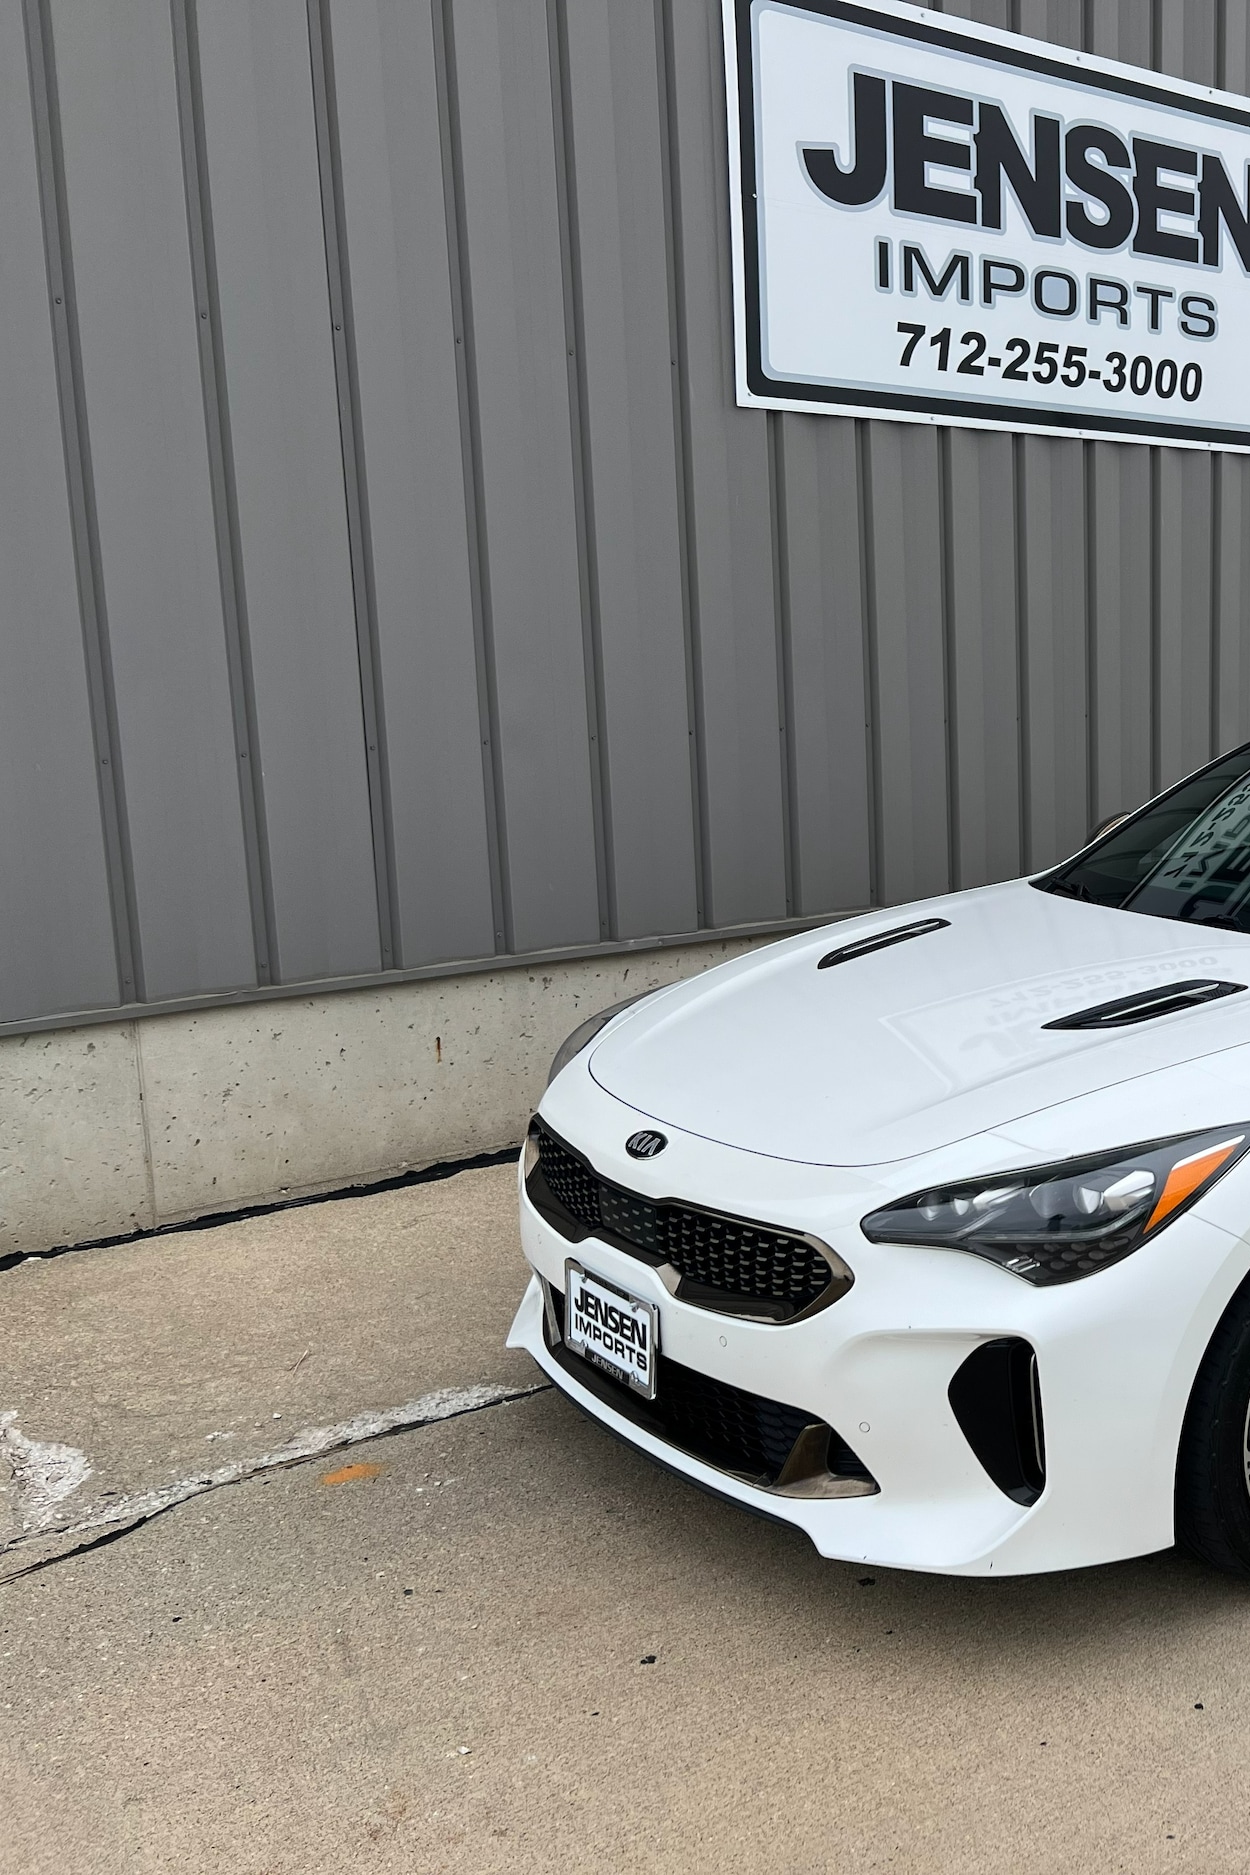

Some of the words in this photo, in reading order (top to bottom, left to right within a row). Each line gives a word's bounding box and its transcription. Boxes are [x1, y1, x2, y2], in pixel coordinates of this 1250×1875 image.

[877, 240, 1217, 339] IMPORTS
[896, 321, 1203, 402] 712-255-3000
[627, 1131, 662, 1156] KIA
[574, 1286, 647, 1351] JENSEN
[574, 1313, 648, 1372] IMPORTS
[590, 1354, 624, 1380] JENSEN
